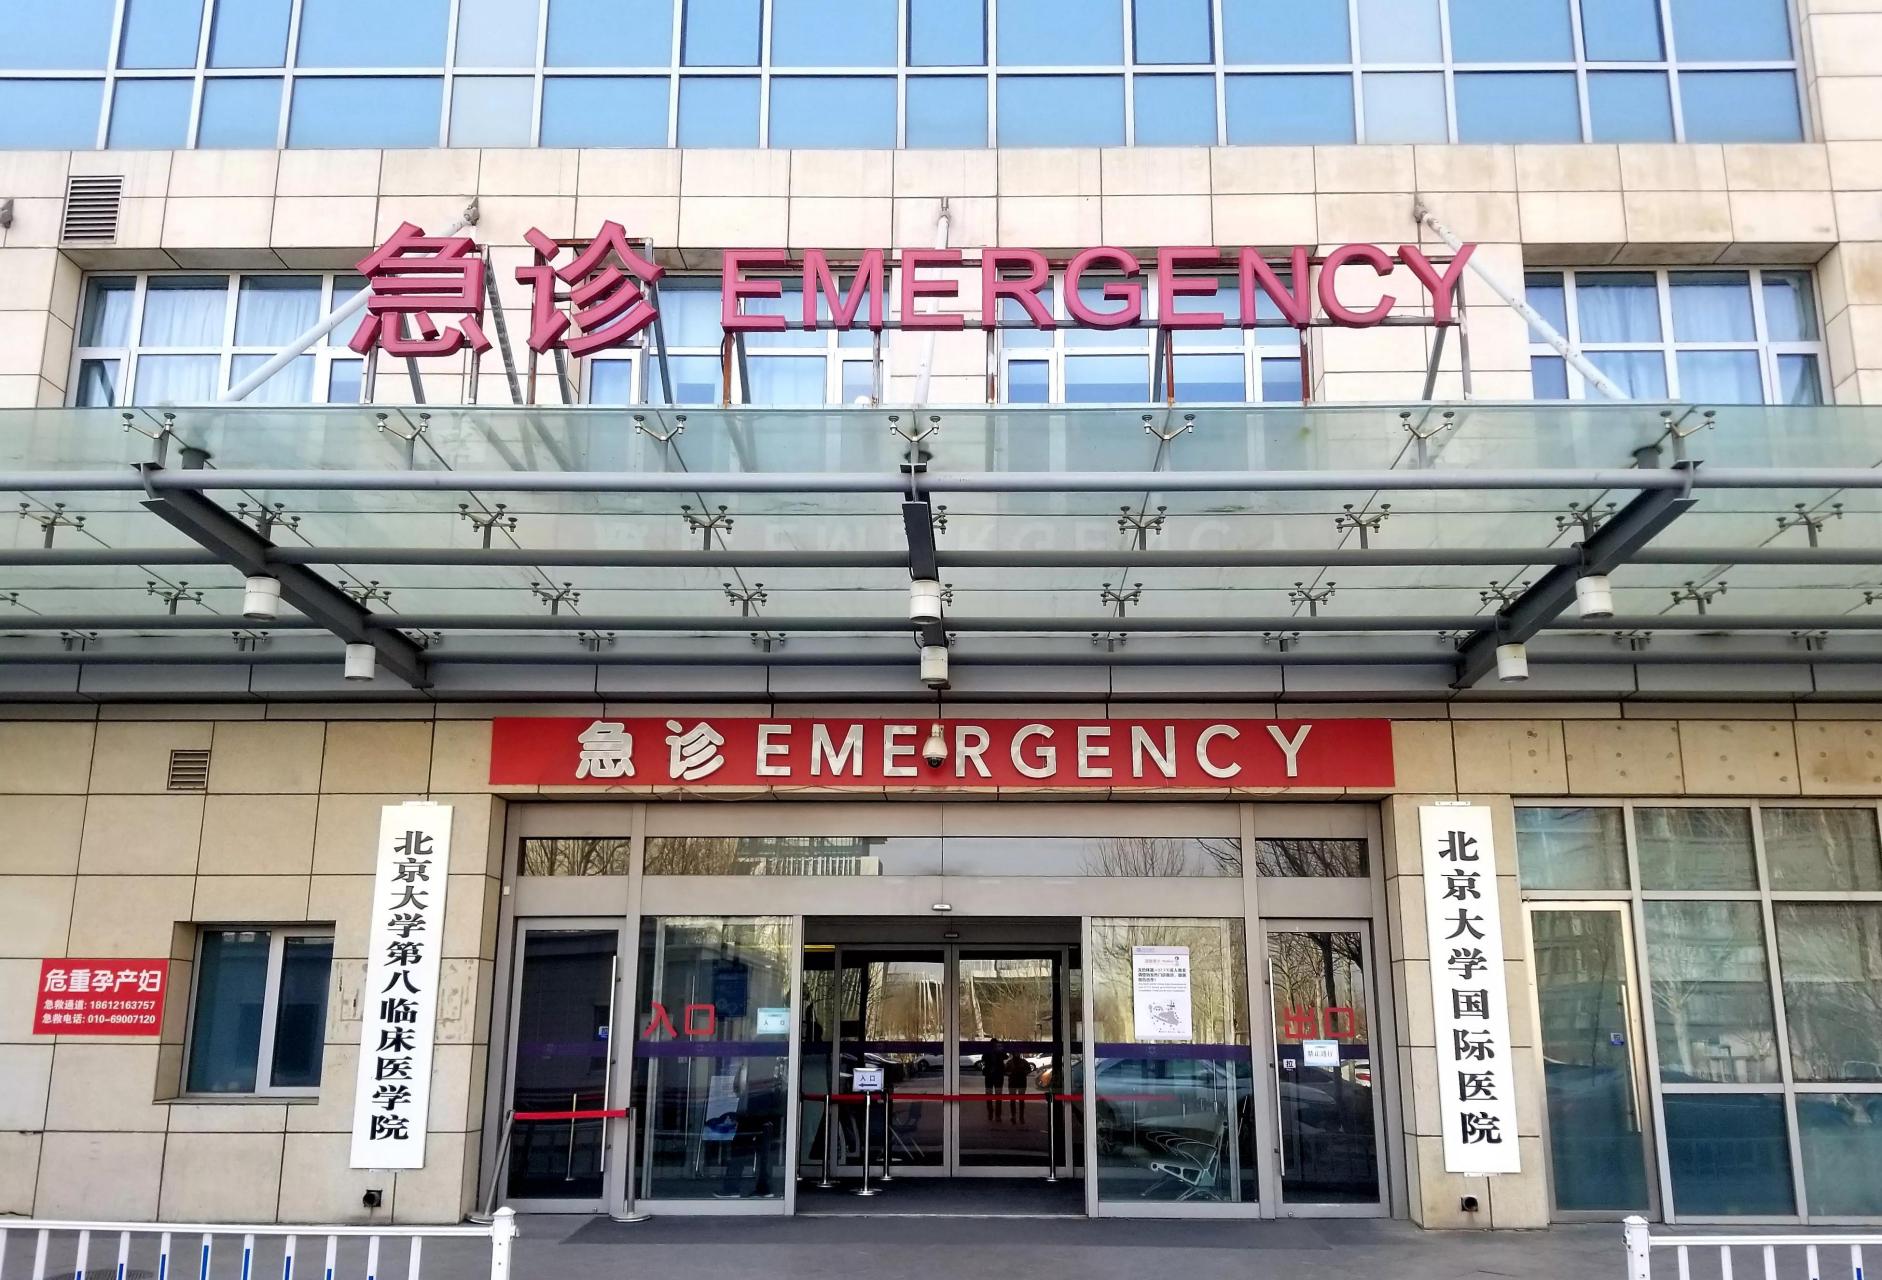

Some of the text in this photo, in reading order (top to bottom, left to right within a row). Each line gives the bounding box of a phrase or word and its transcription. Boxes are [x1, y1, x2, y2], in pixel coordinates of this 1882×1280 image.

[347, 220, 1478, 358] 急诊 EMERGENCY
[575, 719, 1313, 781] 急诊 EMERGENCY
[44, 968, 162, 993] 危重孕产妇
[369, 829, 434, 1142] 北京大学第八临床医学院
[1438, 830, 1503, 1145] 北京大学国际医院
[87, 1014, 156, 1024] 010-69007120
[90, 1000, 156, 1010] 18612163757
[643, 1001, 715, 1038] 入口
[1283, 1004, 1355, 1039] 出口
[860, 1074, 876, 1082] 入口
